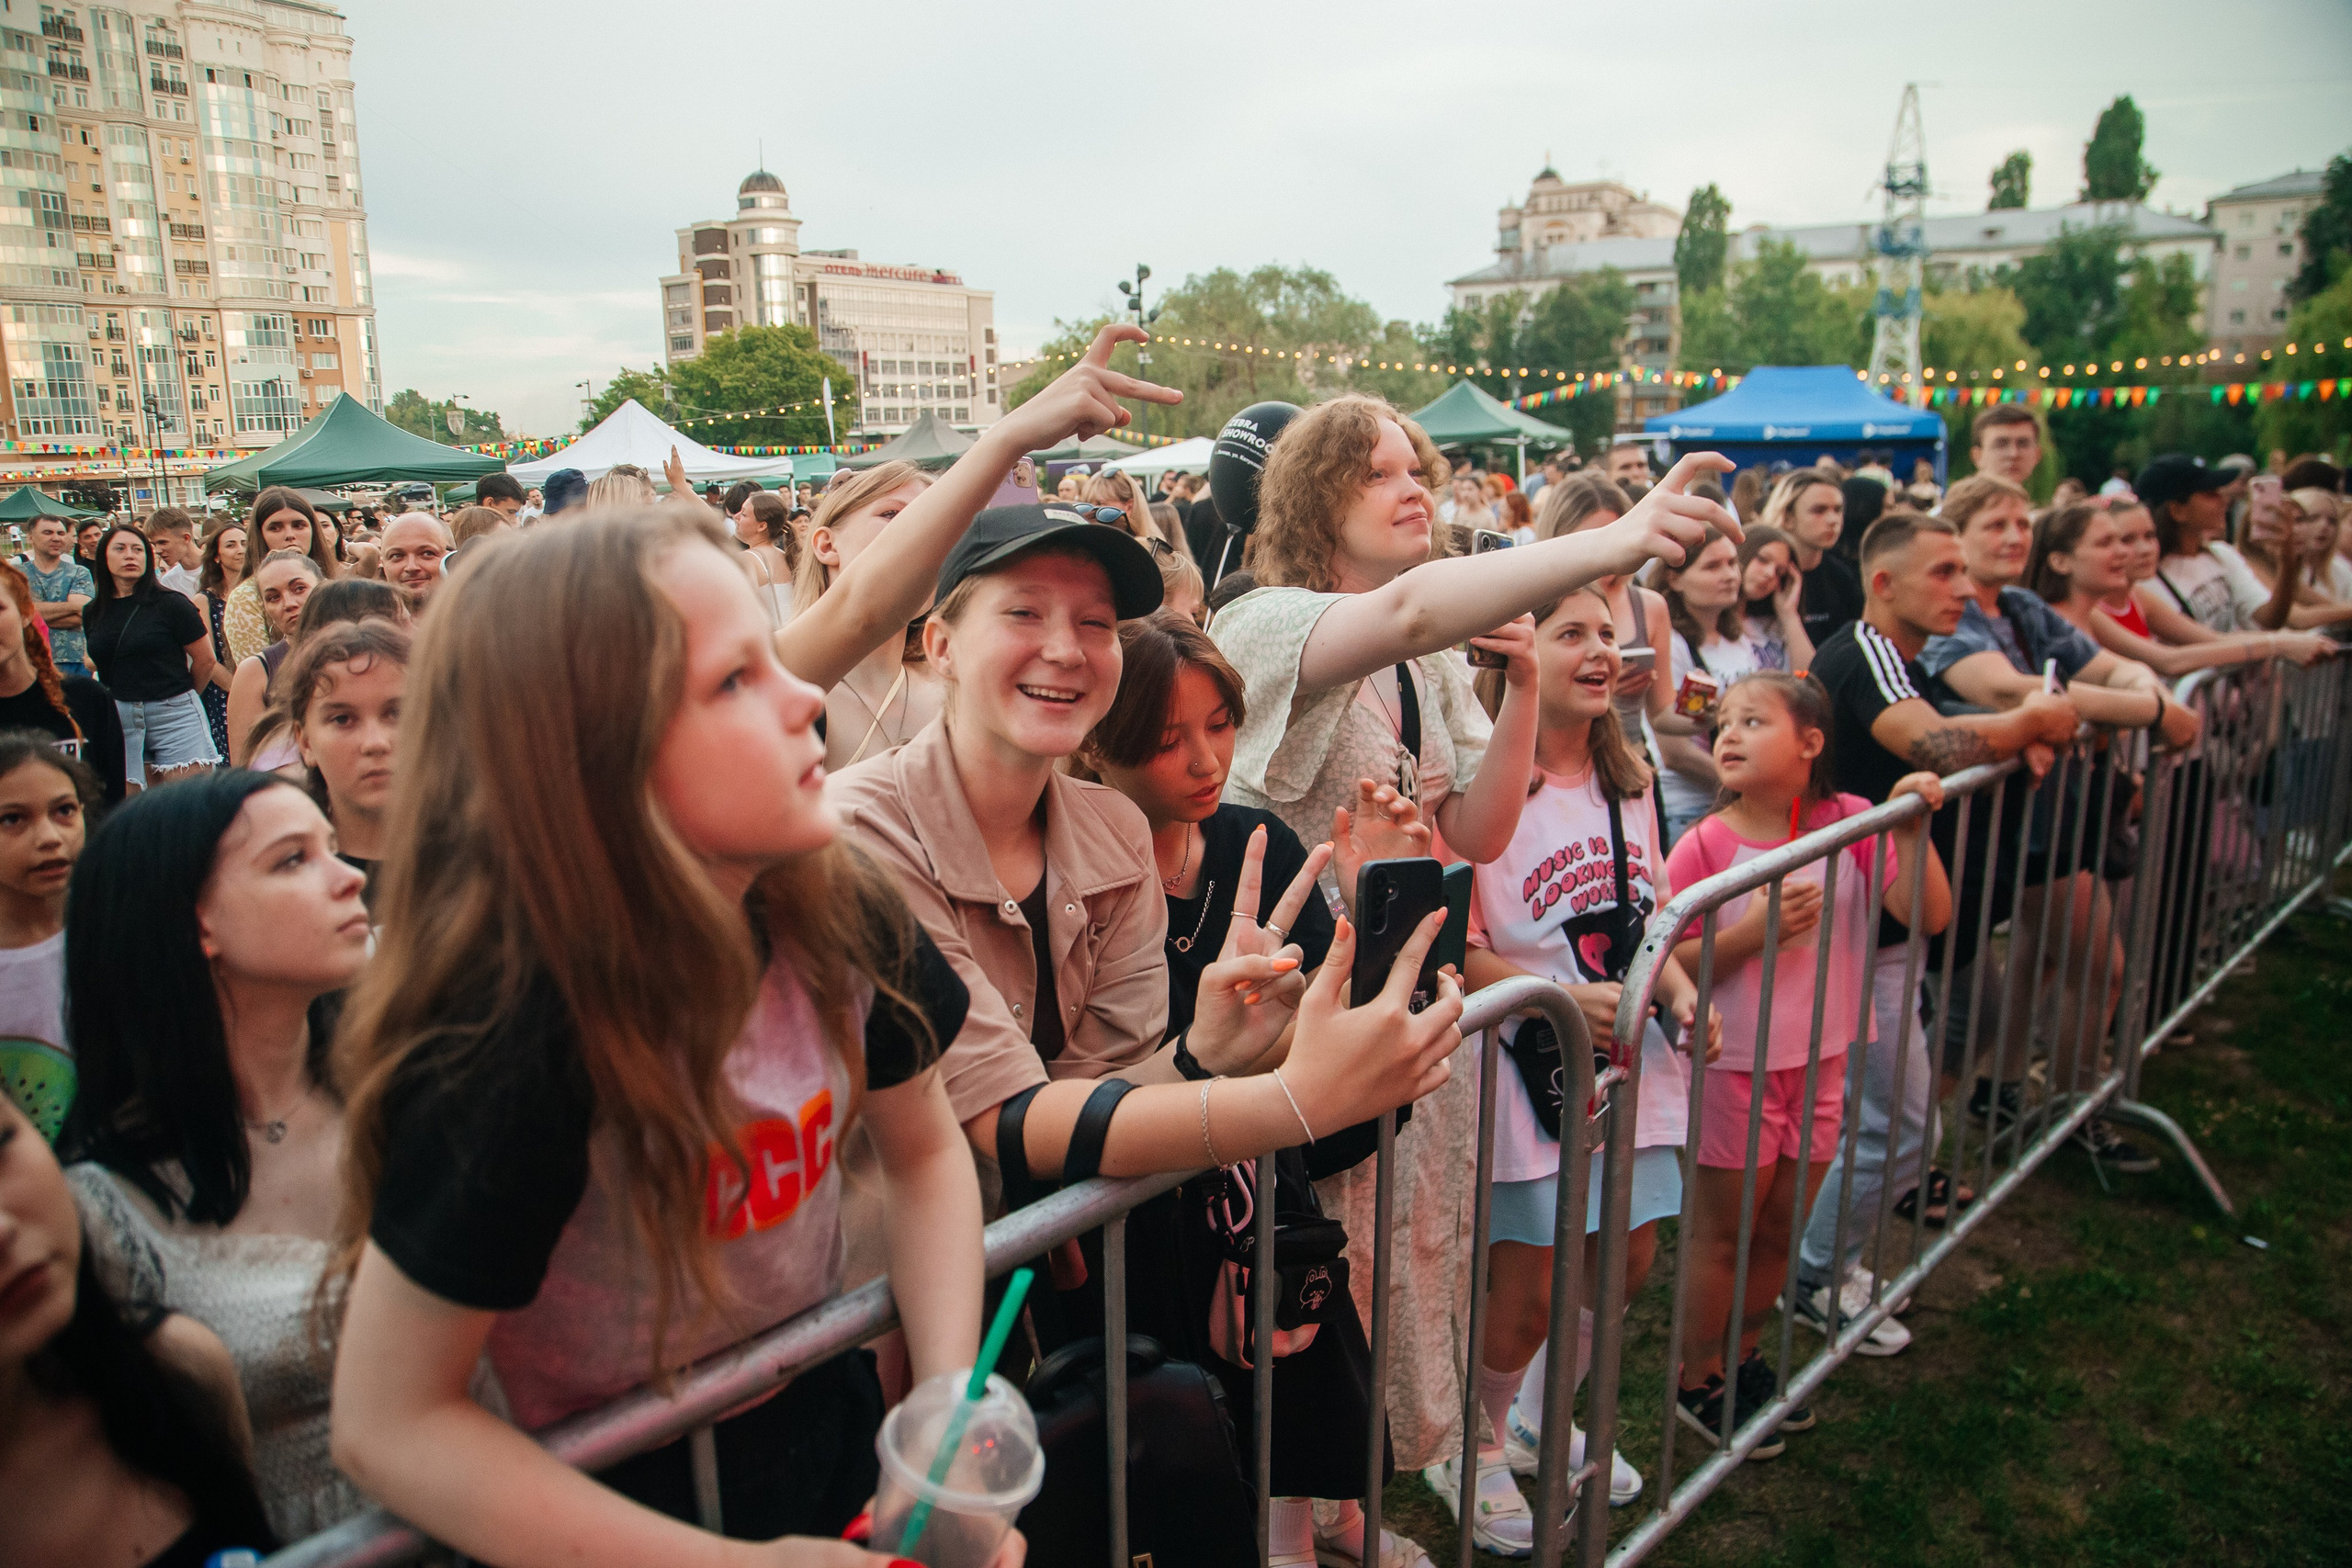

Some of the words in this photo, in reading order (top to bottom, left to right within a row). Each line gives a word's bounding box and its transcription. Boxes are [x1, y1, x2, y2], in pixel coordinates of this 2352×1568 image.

[1221, 428, 1274, 454] SHOWROO
[1227, 418, 1259, 432] ZEBRA
[1522, 841, 1585, 903] MUSIC
[1588, 836, 1609, 855] IS
[1532, 860, 1617, 921] LOOKING
